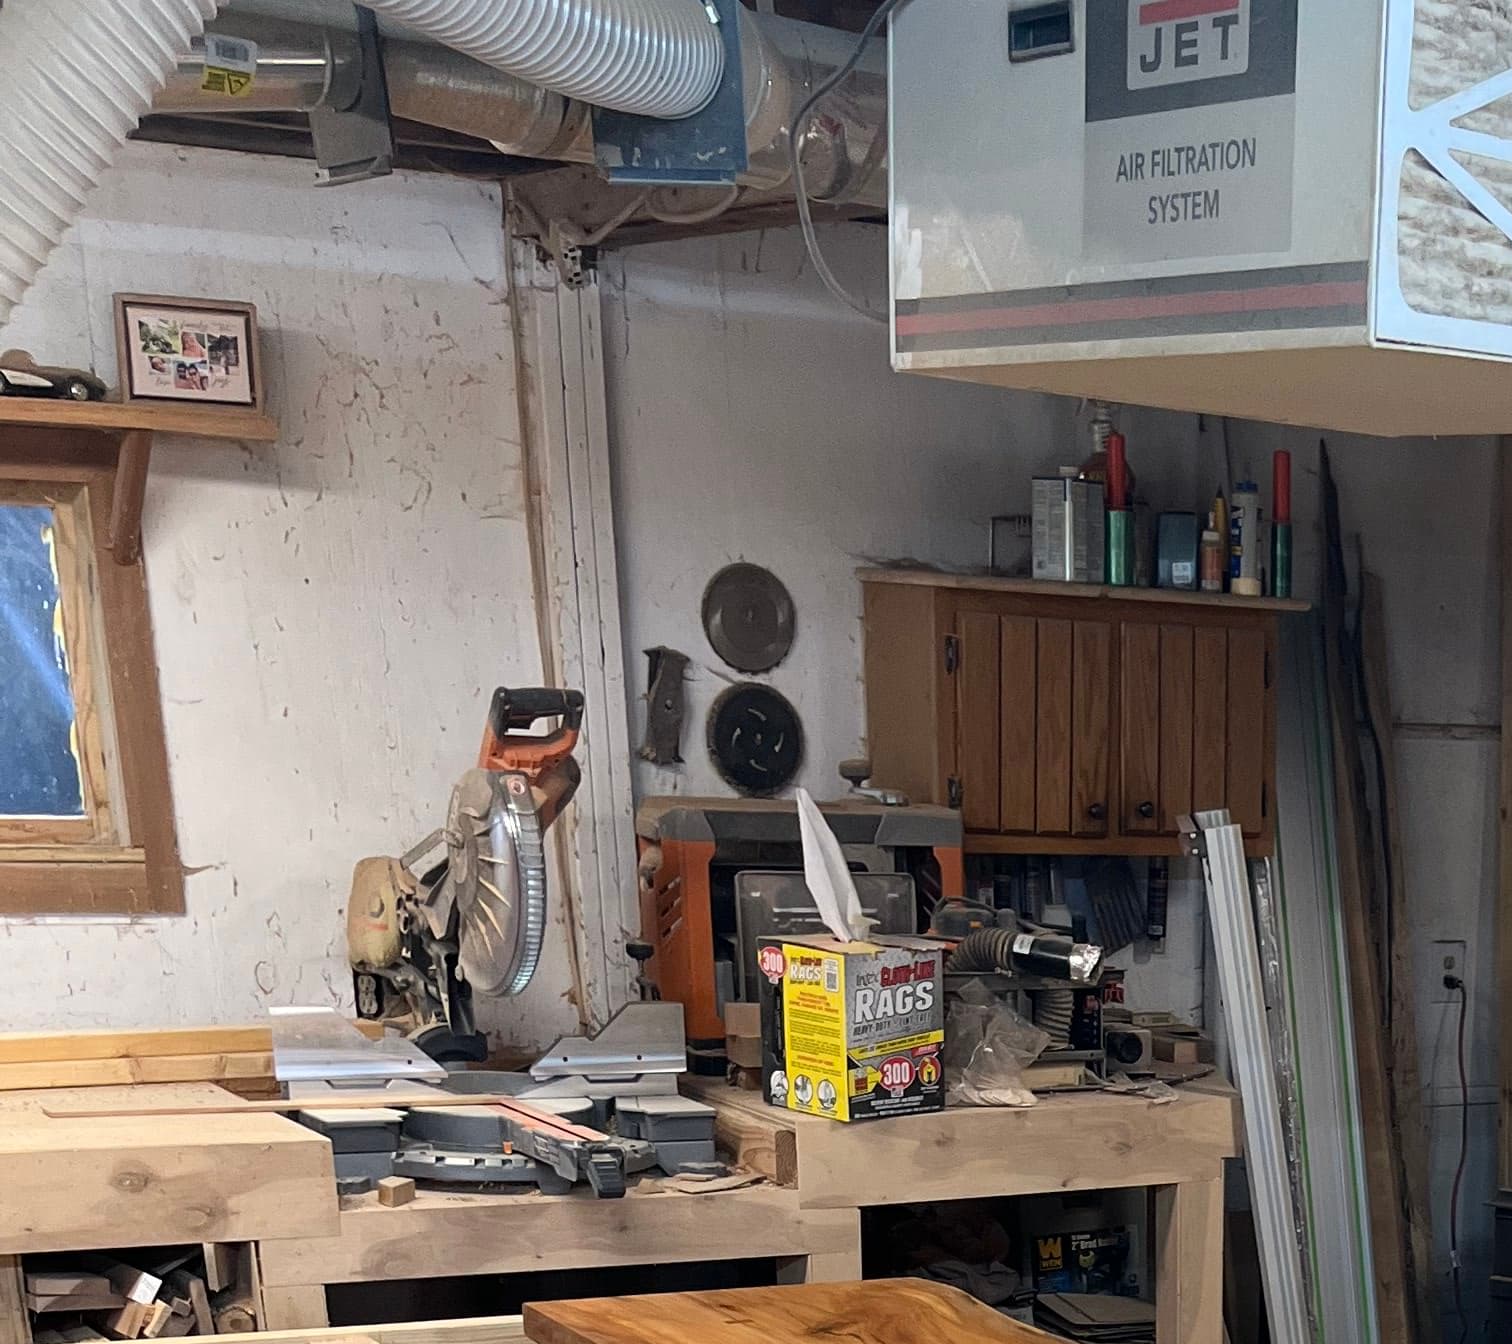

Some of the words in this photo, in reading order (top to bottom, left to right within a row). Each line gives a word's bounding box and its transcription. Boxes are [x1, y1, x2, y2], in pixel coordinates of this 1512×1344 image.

[1139, 14, 1239, 73] JET
[1116, 152, 1145, 182] AIR
[1151, 138, 1256, 177] FILTRATION
[1148, 189, 1219, 224] SYSTEM
[763, 951, 783, 973] 300
[791, 964, 820, 980] RAGS
[855, 981, 934, 1023] RAGS
[883, 1062, 909, 1085] 300
